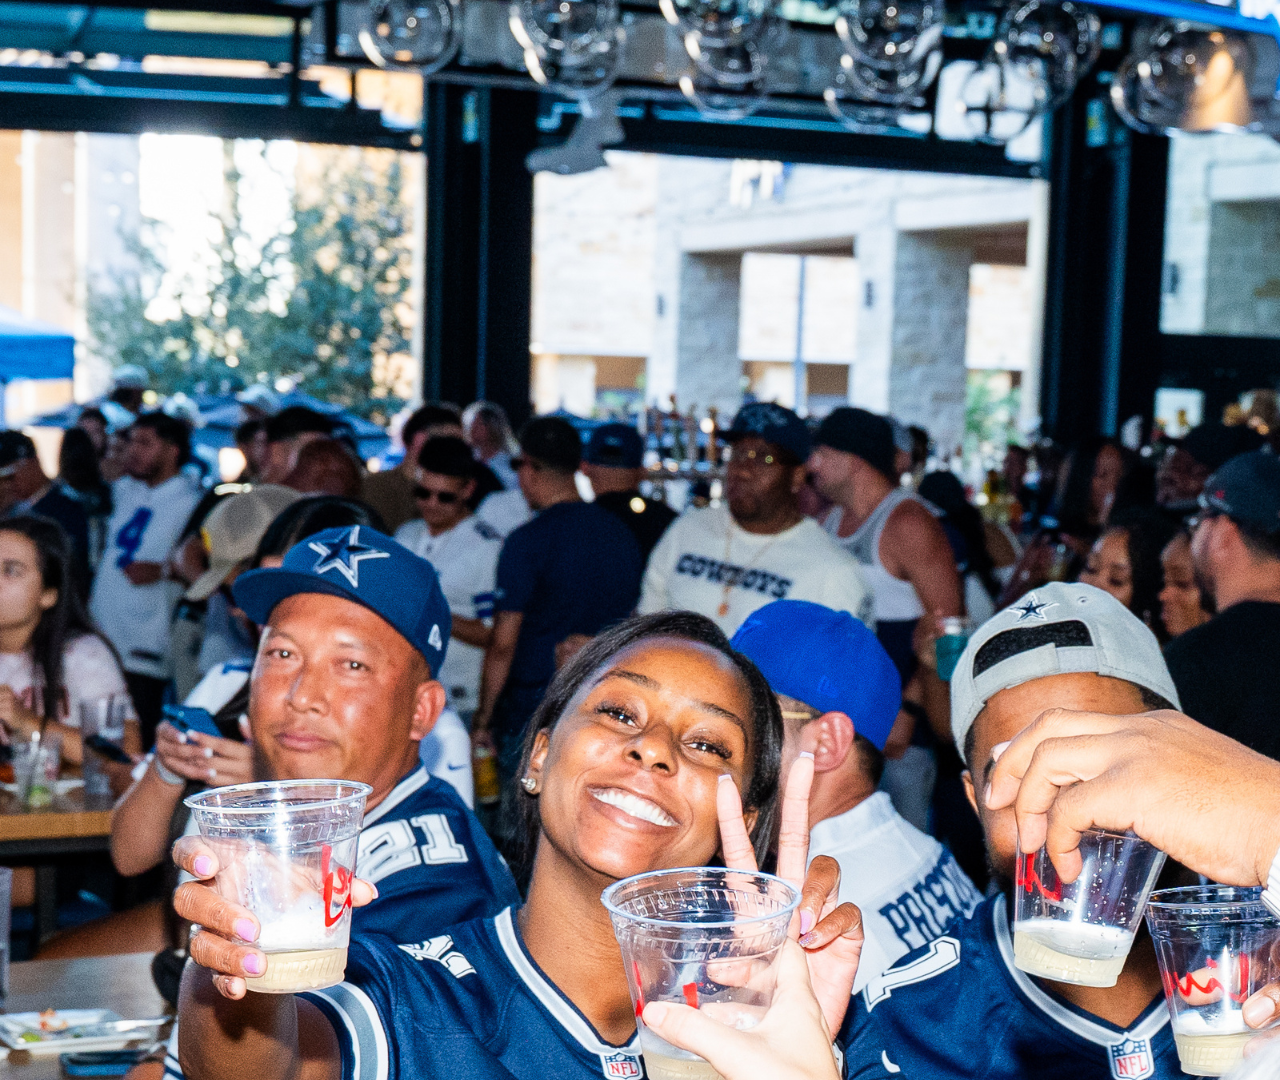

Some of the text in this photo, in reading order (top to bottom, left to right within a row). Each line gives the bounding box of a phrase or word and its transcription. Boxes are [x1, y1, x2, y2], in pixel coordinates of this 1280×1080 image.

[115, 506, 153, 569] 4
[676, 553, 792, 599] COWBOYS
[354, 814, 468, 887] 21
[610, 1062, 638, 1075] NFL
[1116, 1054, 1148, 1076] NFL
